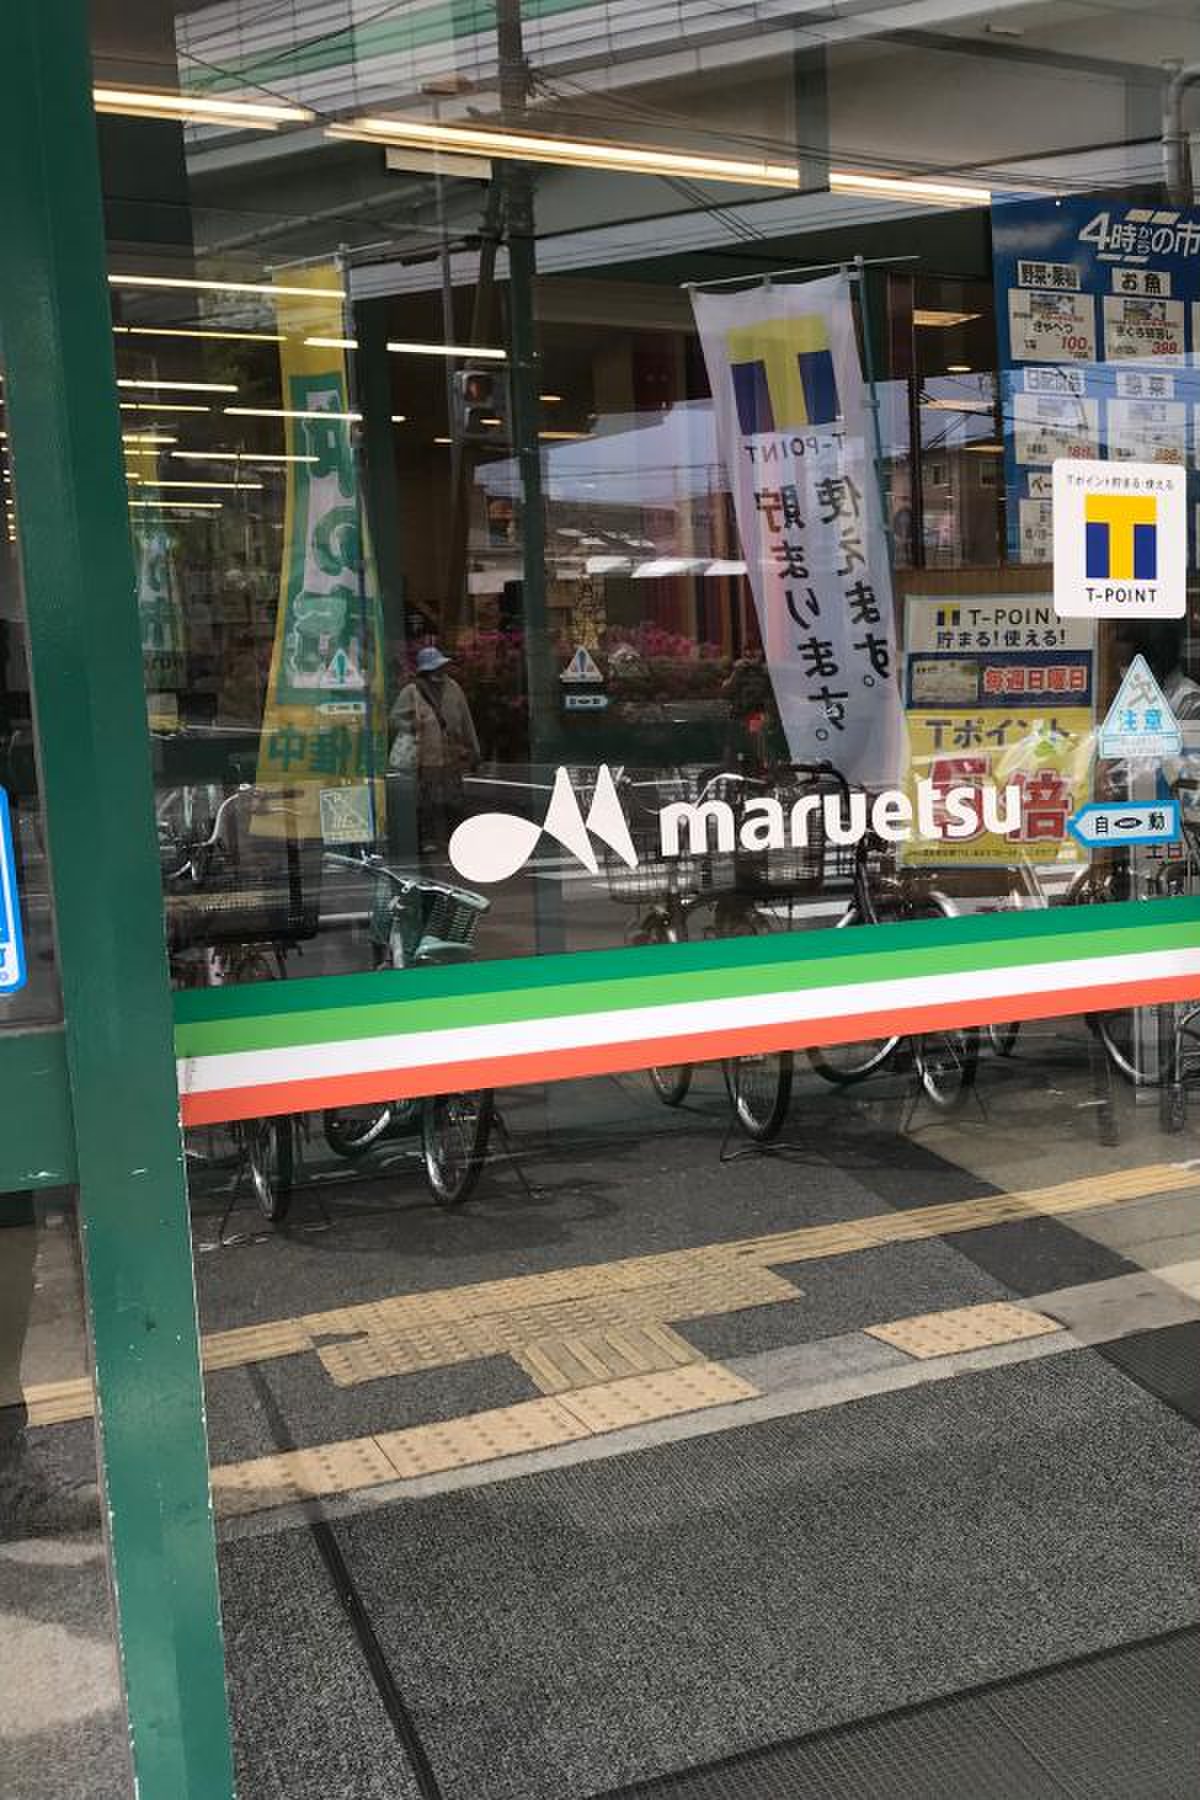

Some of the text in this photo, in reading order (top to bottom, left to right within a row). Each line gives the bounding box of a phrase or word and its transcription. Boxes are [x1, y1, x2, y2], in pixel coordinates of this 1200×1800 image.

[1061, 336, 1088, 351] 100
[1085, 588, 1157, 603] T-POINT
[968, 608, 1063, 626] T-POIN
[984, 666, 1088, 693] 毎週日曜日
[1119, 708, 1164, 731] 注意
[659, 778, 1022, 857] maruetsu
